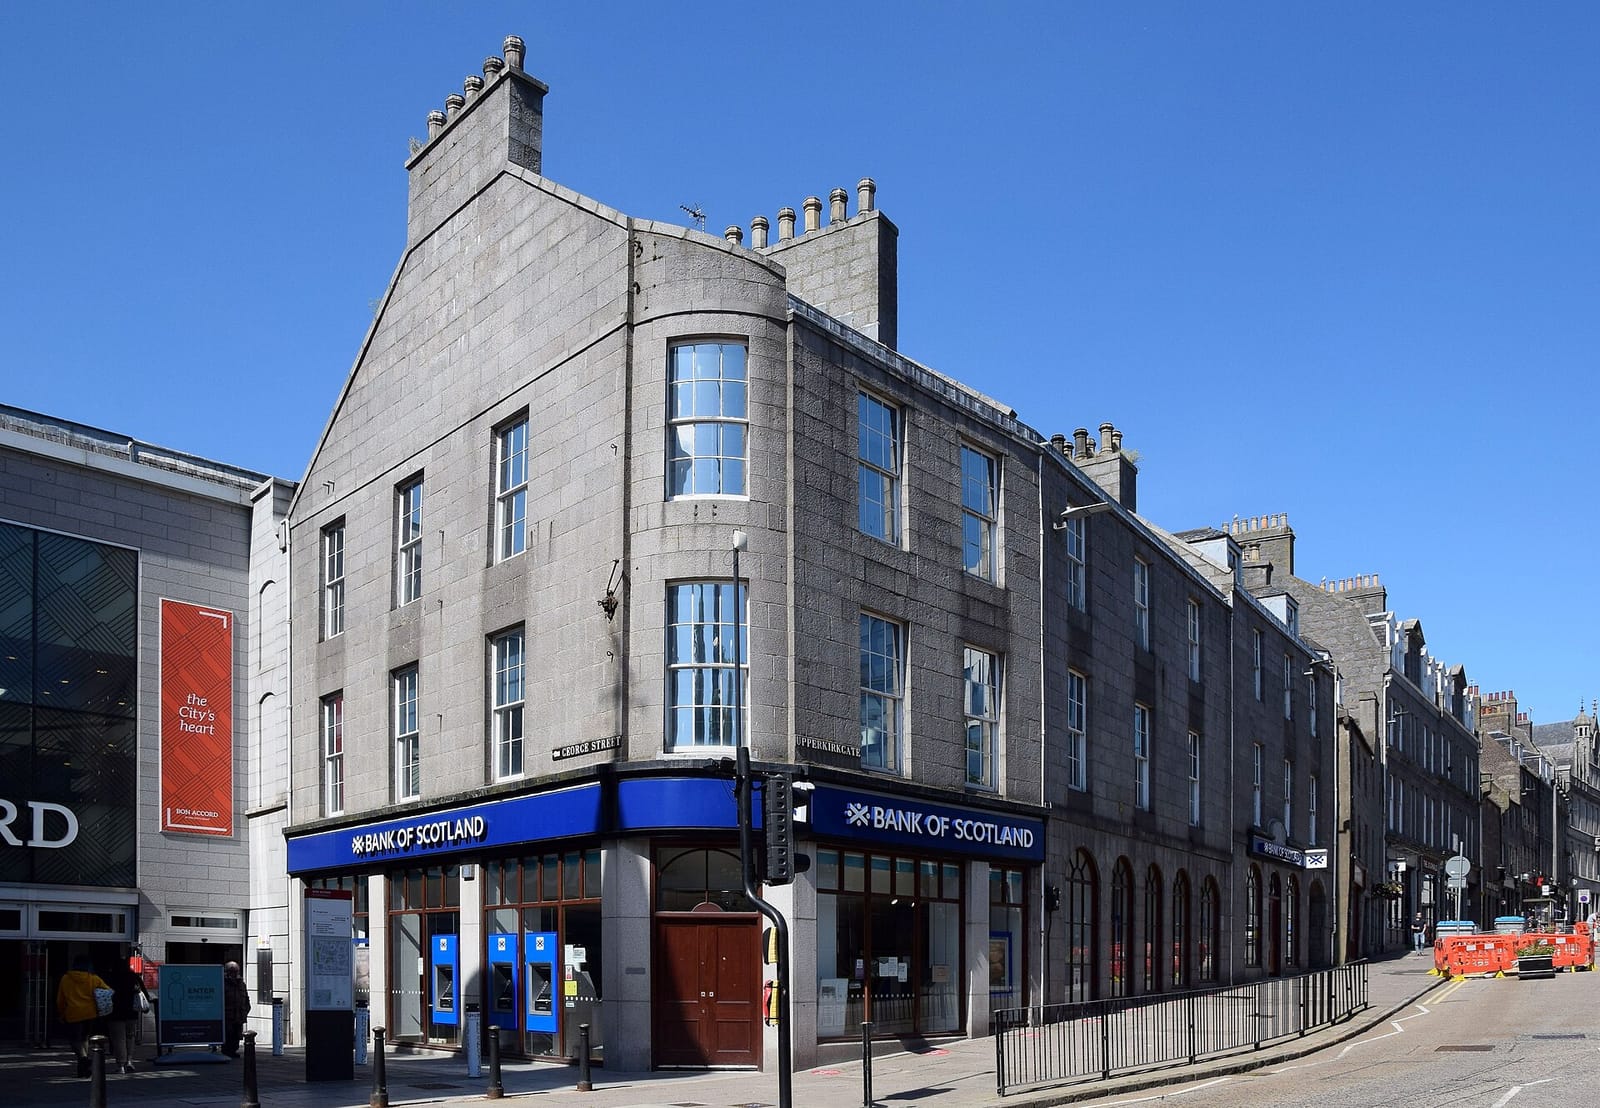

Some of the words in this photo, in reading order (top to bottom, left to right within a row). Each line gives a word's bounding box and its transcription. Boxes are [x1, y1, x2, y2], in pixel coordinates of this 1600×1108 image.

[187, 693, 208, 706] the
[179, 706, 215, 721] City's
[180, 720, 215, 735] heart
[561, 742, 589, 757] GEORGE
[591, 736, 621, 751] STREET
[796, 735, 861, 757] UPPERKIRKGATE
[192, 810, 219, 818] ACCORD
[365, 830, 395, 852] BANK
[397, 827, 414, 848] OF
[416, 816, 484, 845] SCOTLAND
[873, 806, 923, 834] BANK
[925, 815, 950, 837] OF
[953, 818, 1034, 848] SCOTLAND
